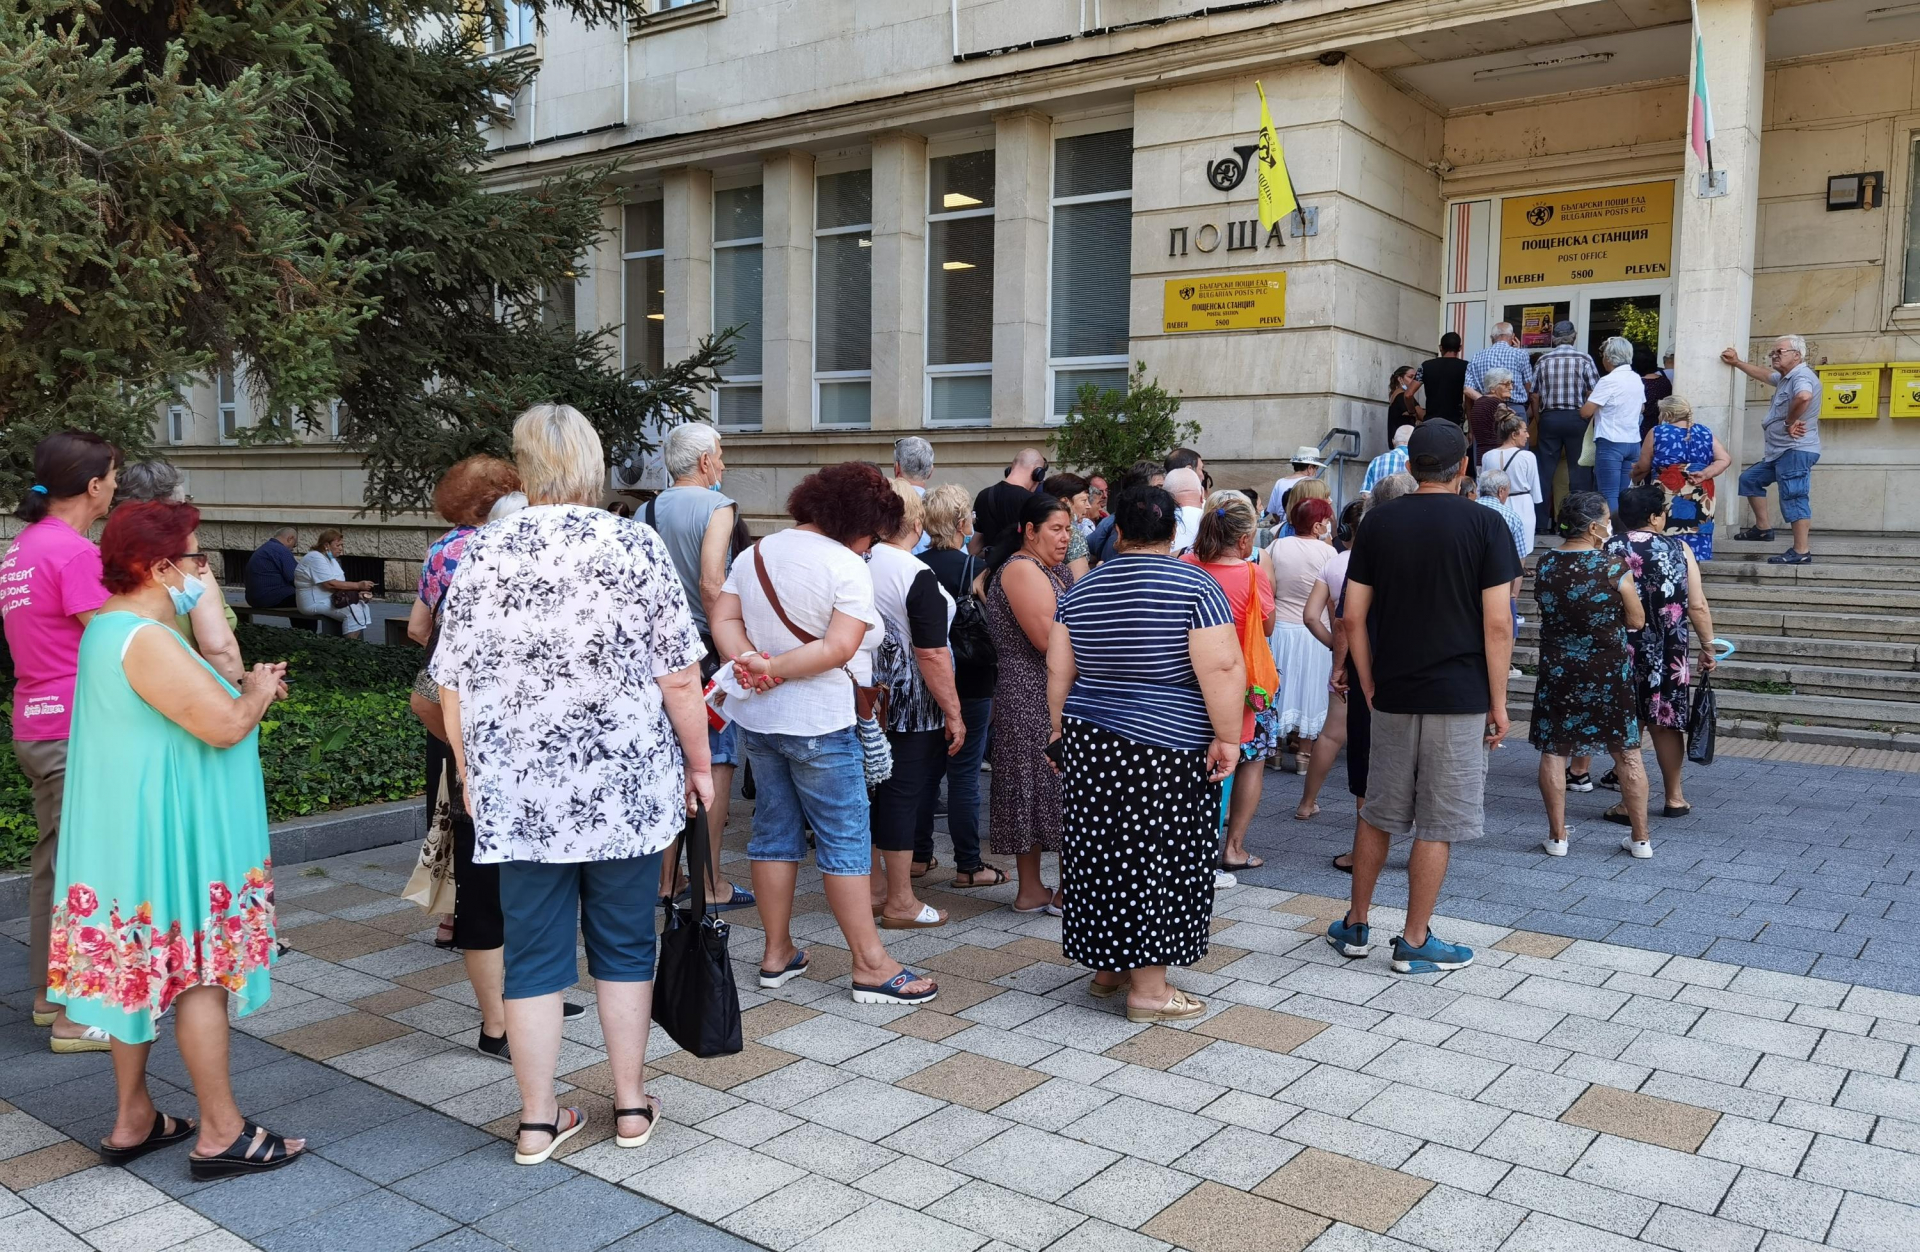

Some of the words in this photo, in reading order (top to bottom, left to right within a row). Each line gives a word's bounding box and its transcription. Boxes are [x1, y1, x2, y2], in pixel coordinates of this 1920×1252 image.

[1561, 201, 1603, 212] БЪЛГАРСКИ
[1605, 198, 1629, 207] ПОЩИ
[1631, 196, 1646, 204] ЕАД
[1561, 210, 1603, 221] BULGARIAN
[1605, 208, 1629, 217] POSTS
[1631, 206, 1646, 214] PLC
[1169, 220, 1286, 256] ПОЩА
[1522, 235, 1588, 250] ПОЩЕНСКА
[1592, 229, 1649, 244] СТАНЦИЯ
[1558, 253, 1578, 262] POST
[1581, 251, 1608, 260] OFFICE
[1571, 269, 1593, 279] 5800
[1625, 263, 1666, 275] PLEVEN
[1505, 273, 1545, 284] ПЛЕВЕН
[1199, 281, 1234, 290] БЪЛГАРСКИ
[1199, 289, 1233, 298] BULGARIAN
[1234, 288, 1254, 296] POSTS
[1192, 302, 1226, 312] ПОЩЕНСКА
[1227, 300, 1255, 310] СТАНЦИЯ
[1166, 321, 1188, 330] ПЛЕВЕН
[1260, 316, 1282, 324] PLEVEN
[8, 566, 35, 581] GREAT
[9, 597, 32, 610] LOVE
